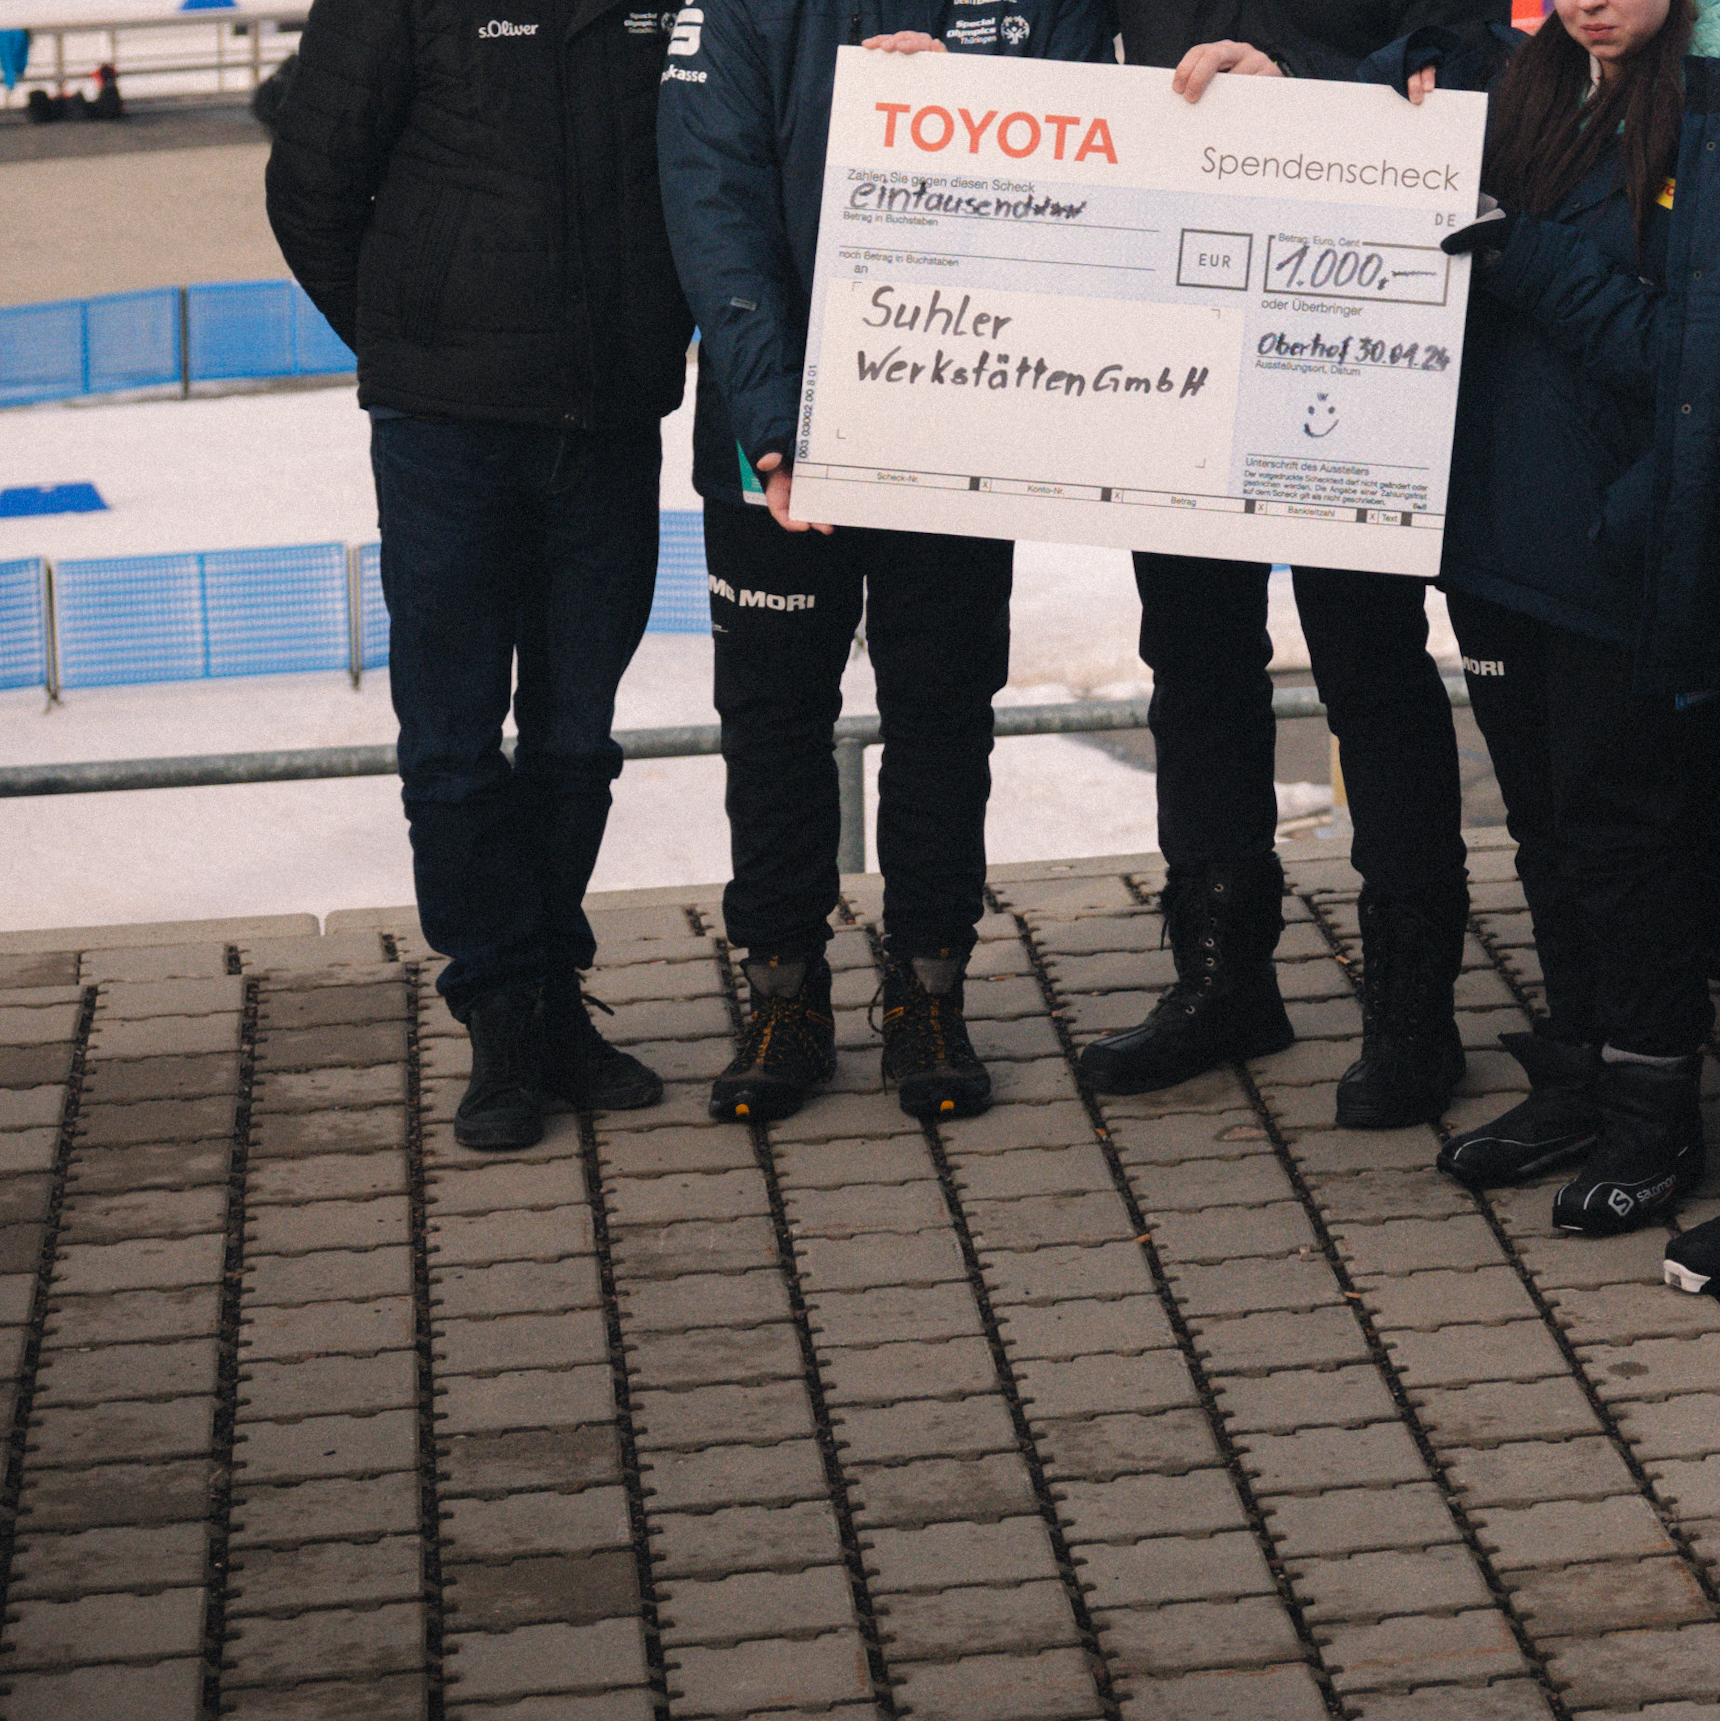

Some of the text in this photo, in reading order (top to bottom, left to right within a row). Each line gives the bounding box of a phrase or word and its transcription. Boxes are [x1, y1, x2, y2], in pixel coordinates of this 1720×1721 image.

[478, 20, 539, 39] s.Oliver
[946, 27, 997, 38] Olympics
[956, 17, 996, 29] Special
[875, 102, 1119, 165] TOYOTA
[1201, 146, 1460, 192] Spendenscheck
[847, 168, 887, 185] Zahlen
[890, 171, 909, 185] Sie
[950, 176, 989, 191] diesen
[991, 179, 1036, 194] Scheck
[843, 210, 940, 228] Betrag in Buchstaben
[838, 248, 960, 268] noch Betrag in Buchstaben
[1198, 252, 1232, 269] EUR
[853, 263, 869, 274] an
[862, 284, 1014, 340] Suhler
[1260, 297, 1364, 317] oder Überbringer
[1256, 331, 1354, 366] Oberhof
[856, 345, 1087, 397] Werkstätten
[1330, 363, 1362, 377] Datum
[798, 439, 810, 459] 003
[1245, 456, 1299, 471] Unterschrift
[1300, 463, 1318, 472] des
[1170, 496, 1197, 508] Betrag
[1381, 513, 1399, 523] Text
[738, 588, 816, 613] MORI
